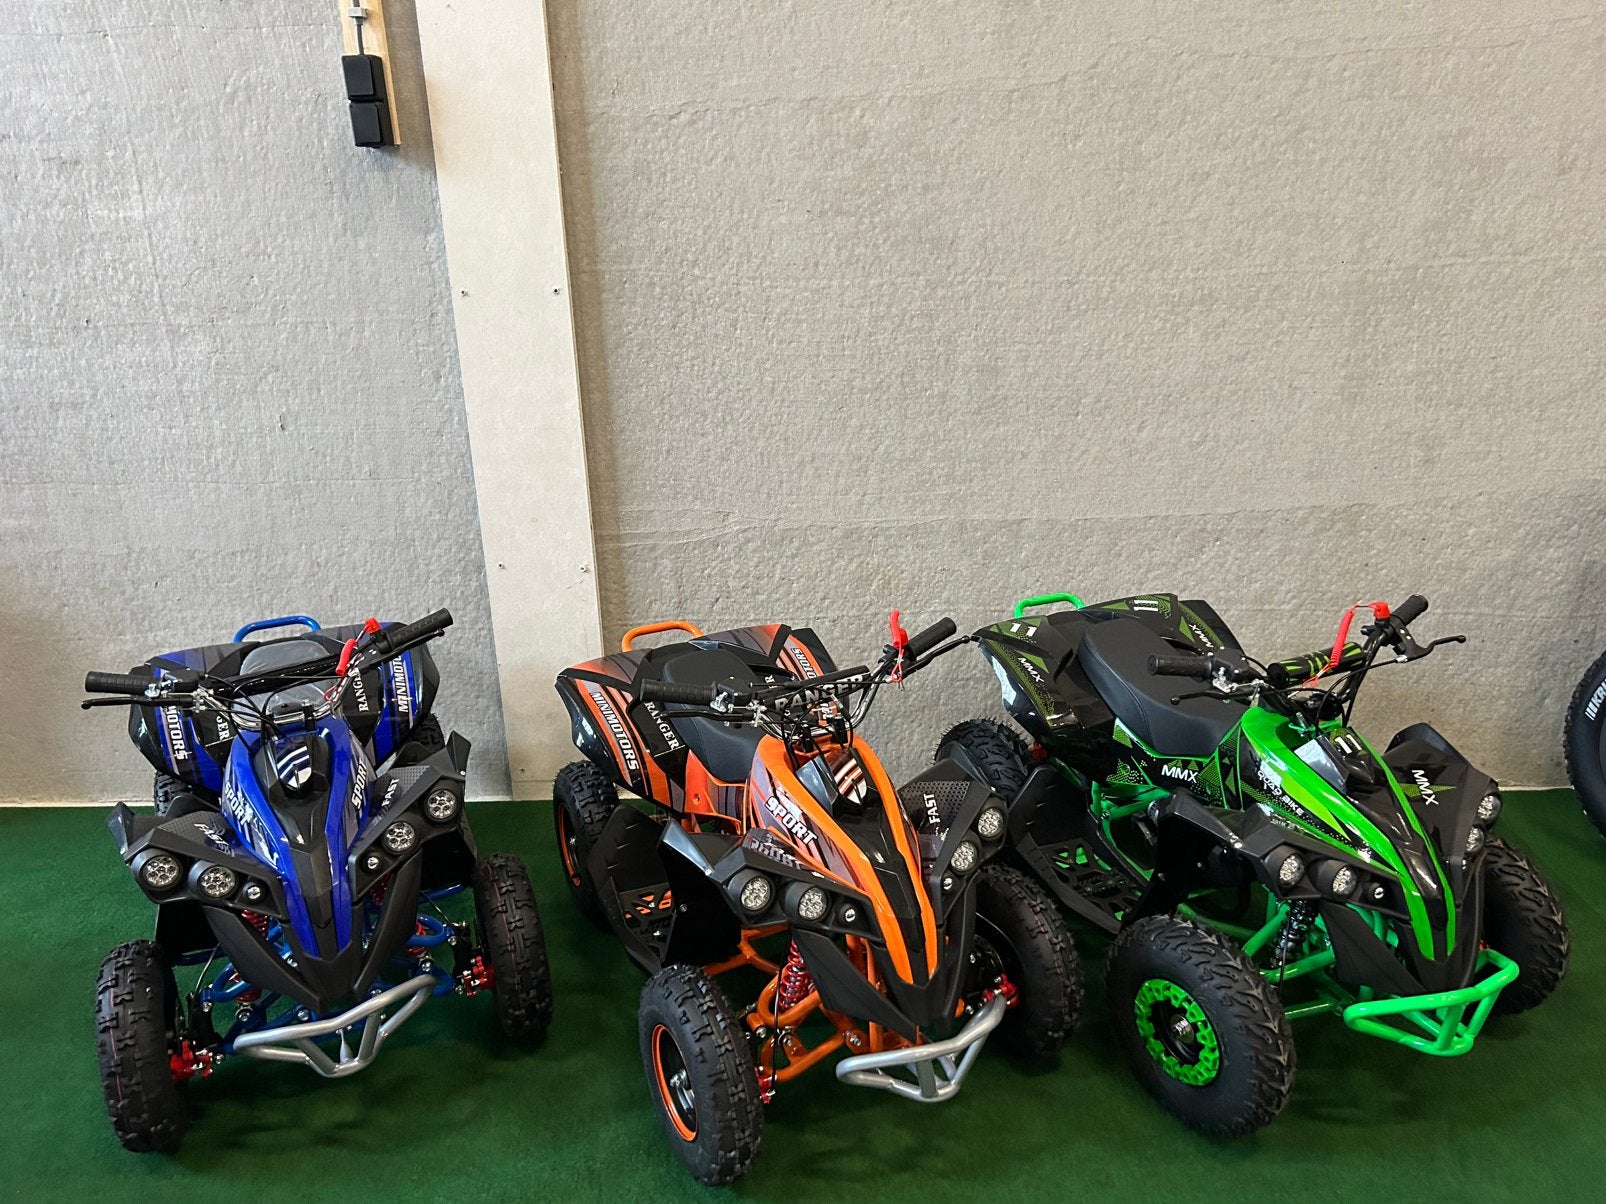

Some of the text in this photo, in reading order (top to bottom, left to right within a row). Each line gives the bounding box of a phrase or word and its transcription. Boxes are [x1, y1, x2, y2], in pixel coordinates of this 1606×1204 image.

[1009, 622, 1038, 637] 11
[1187, 623, 1214, 648] MMX
[1017, 657, 1045, 682] MMX
[165, 706, 189, 759] MOTORS
[589, 691, 640, 770] MINIMOTORS
[644, 701, 680, 750] RANGER
[1334, 734, 1362, 754] 11
[351, 757, 367, 809] SPORT
[1161, 764, 1198, 783] MMX
[1411, 769, 1439, 805] MMX
[381, 778, 400, 807] FAST
[1257, 770, 1305, 816] QUAD BIKE
[765, 796, 818, 845] SPORT
[923, 793, 941, 824] FAST
[193, 823, 230, 846] FAST
